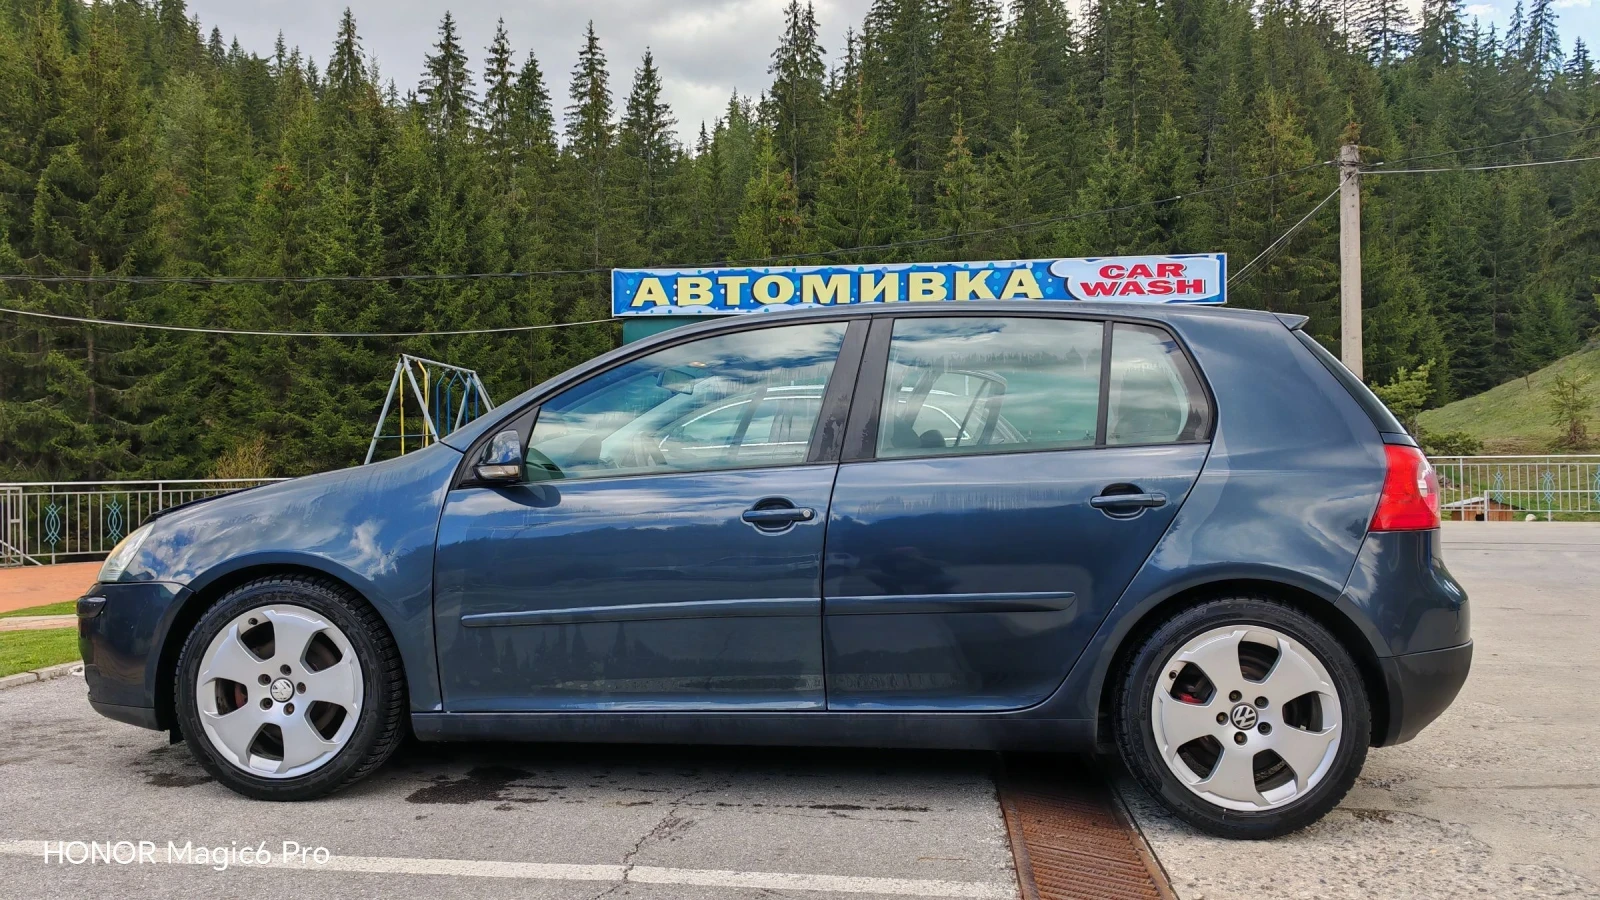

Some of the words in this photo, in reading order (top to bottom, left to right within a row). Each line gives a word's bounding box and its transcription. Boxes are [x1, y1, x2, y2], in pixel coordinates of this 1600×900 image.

[1098, 263, 1187, 279] CAR
[630, 268, 1043, 307] АВТОМИВКА
[1080, 278, 1206, 297] WASH
